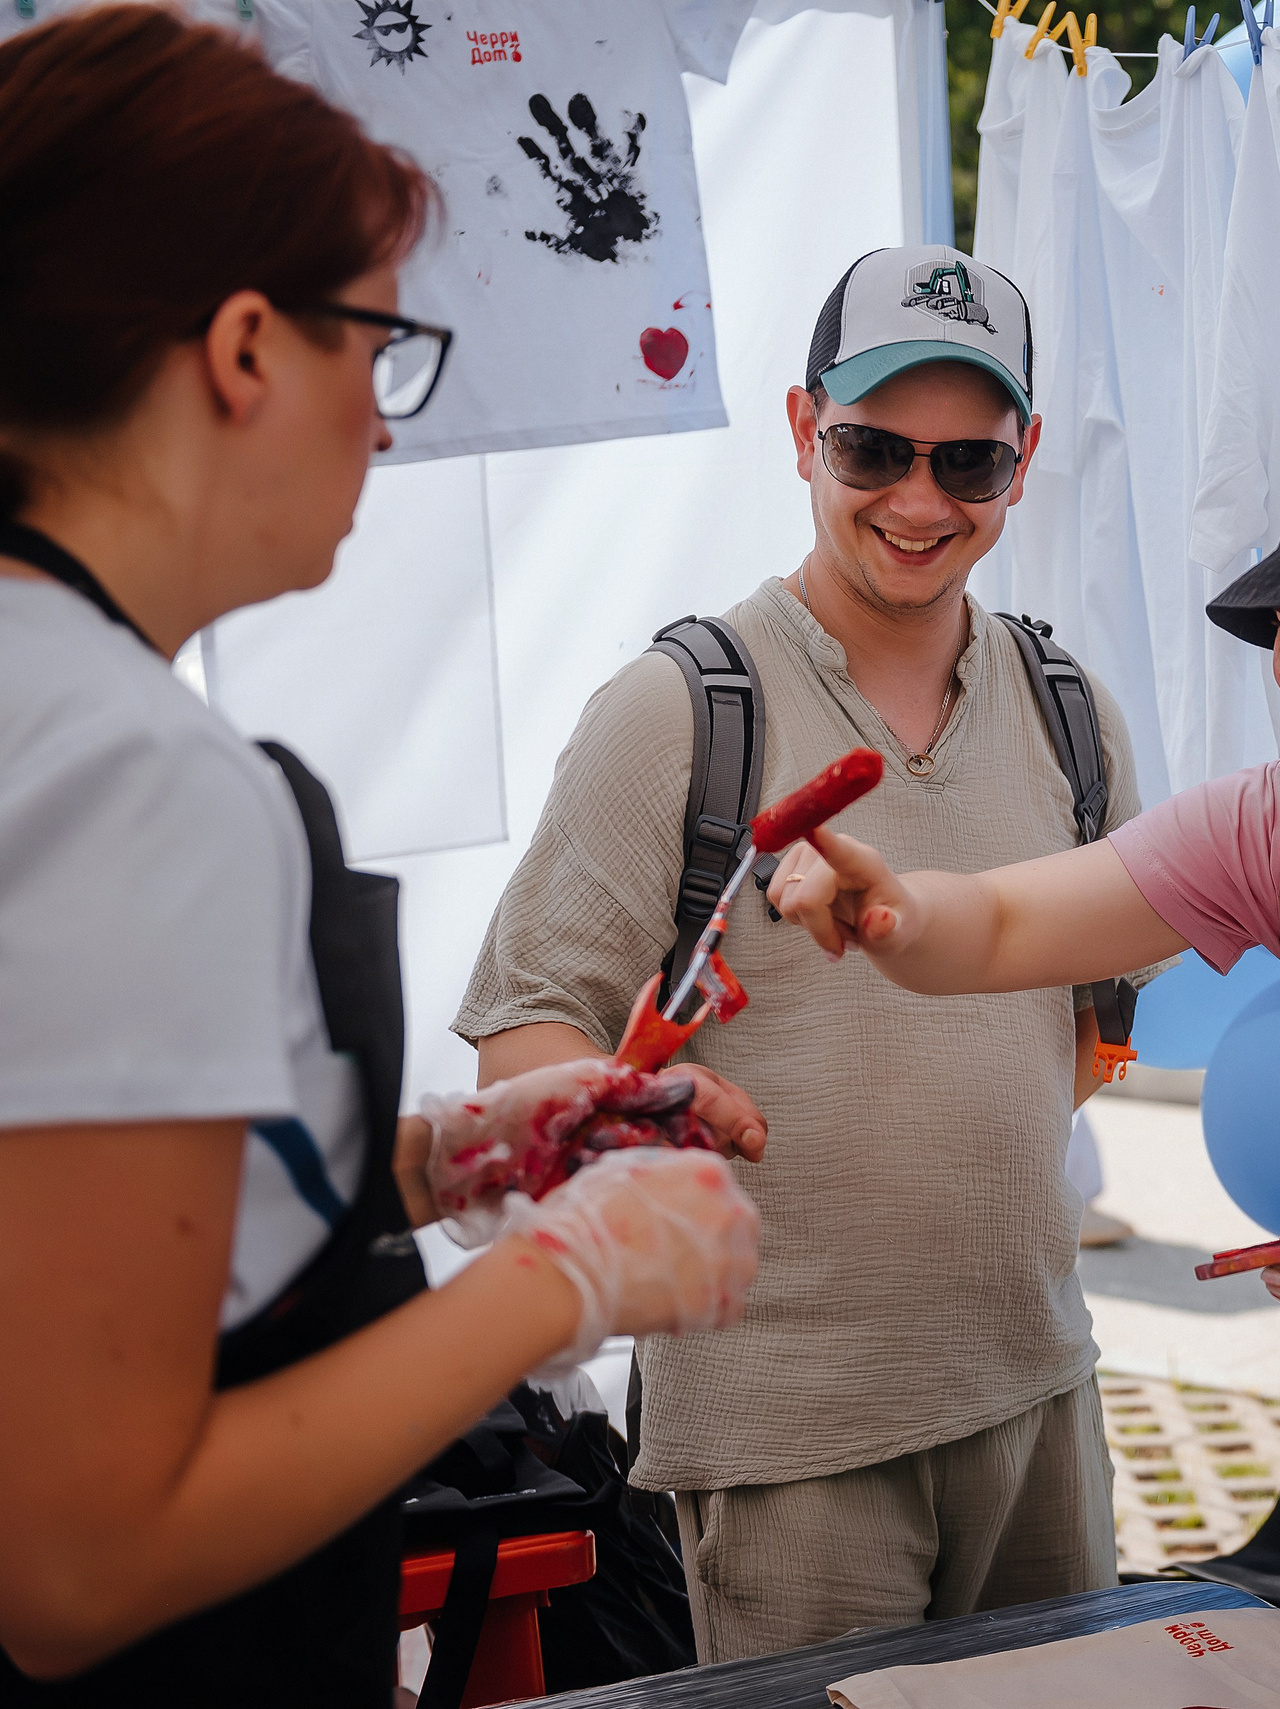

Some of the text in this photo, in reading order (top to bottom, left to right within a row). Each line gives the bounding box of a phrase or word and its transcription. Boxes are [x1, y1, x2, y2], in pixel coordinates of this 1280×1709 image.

[466, 30, 519, 48] Черри
[471, 47, 508, 66] Дот
[1164, 1624, 1206, 1658] Черри
[1196, 1629, 1235, 1652] Дот
